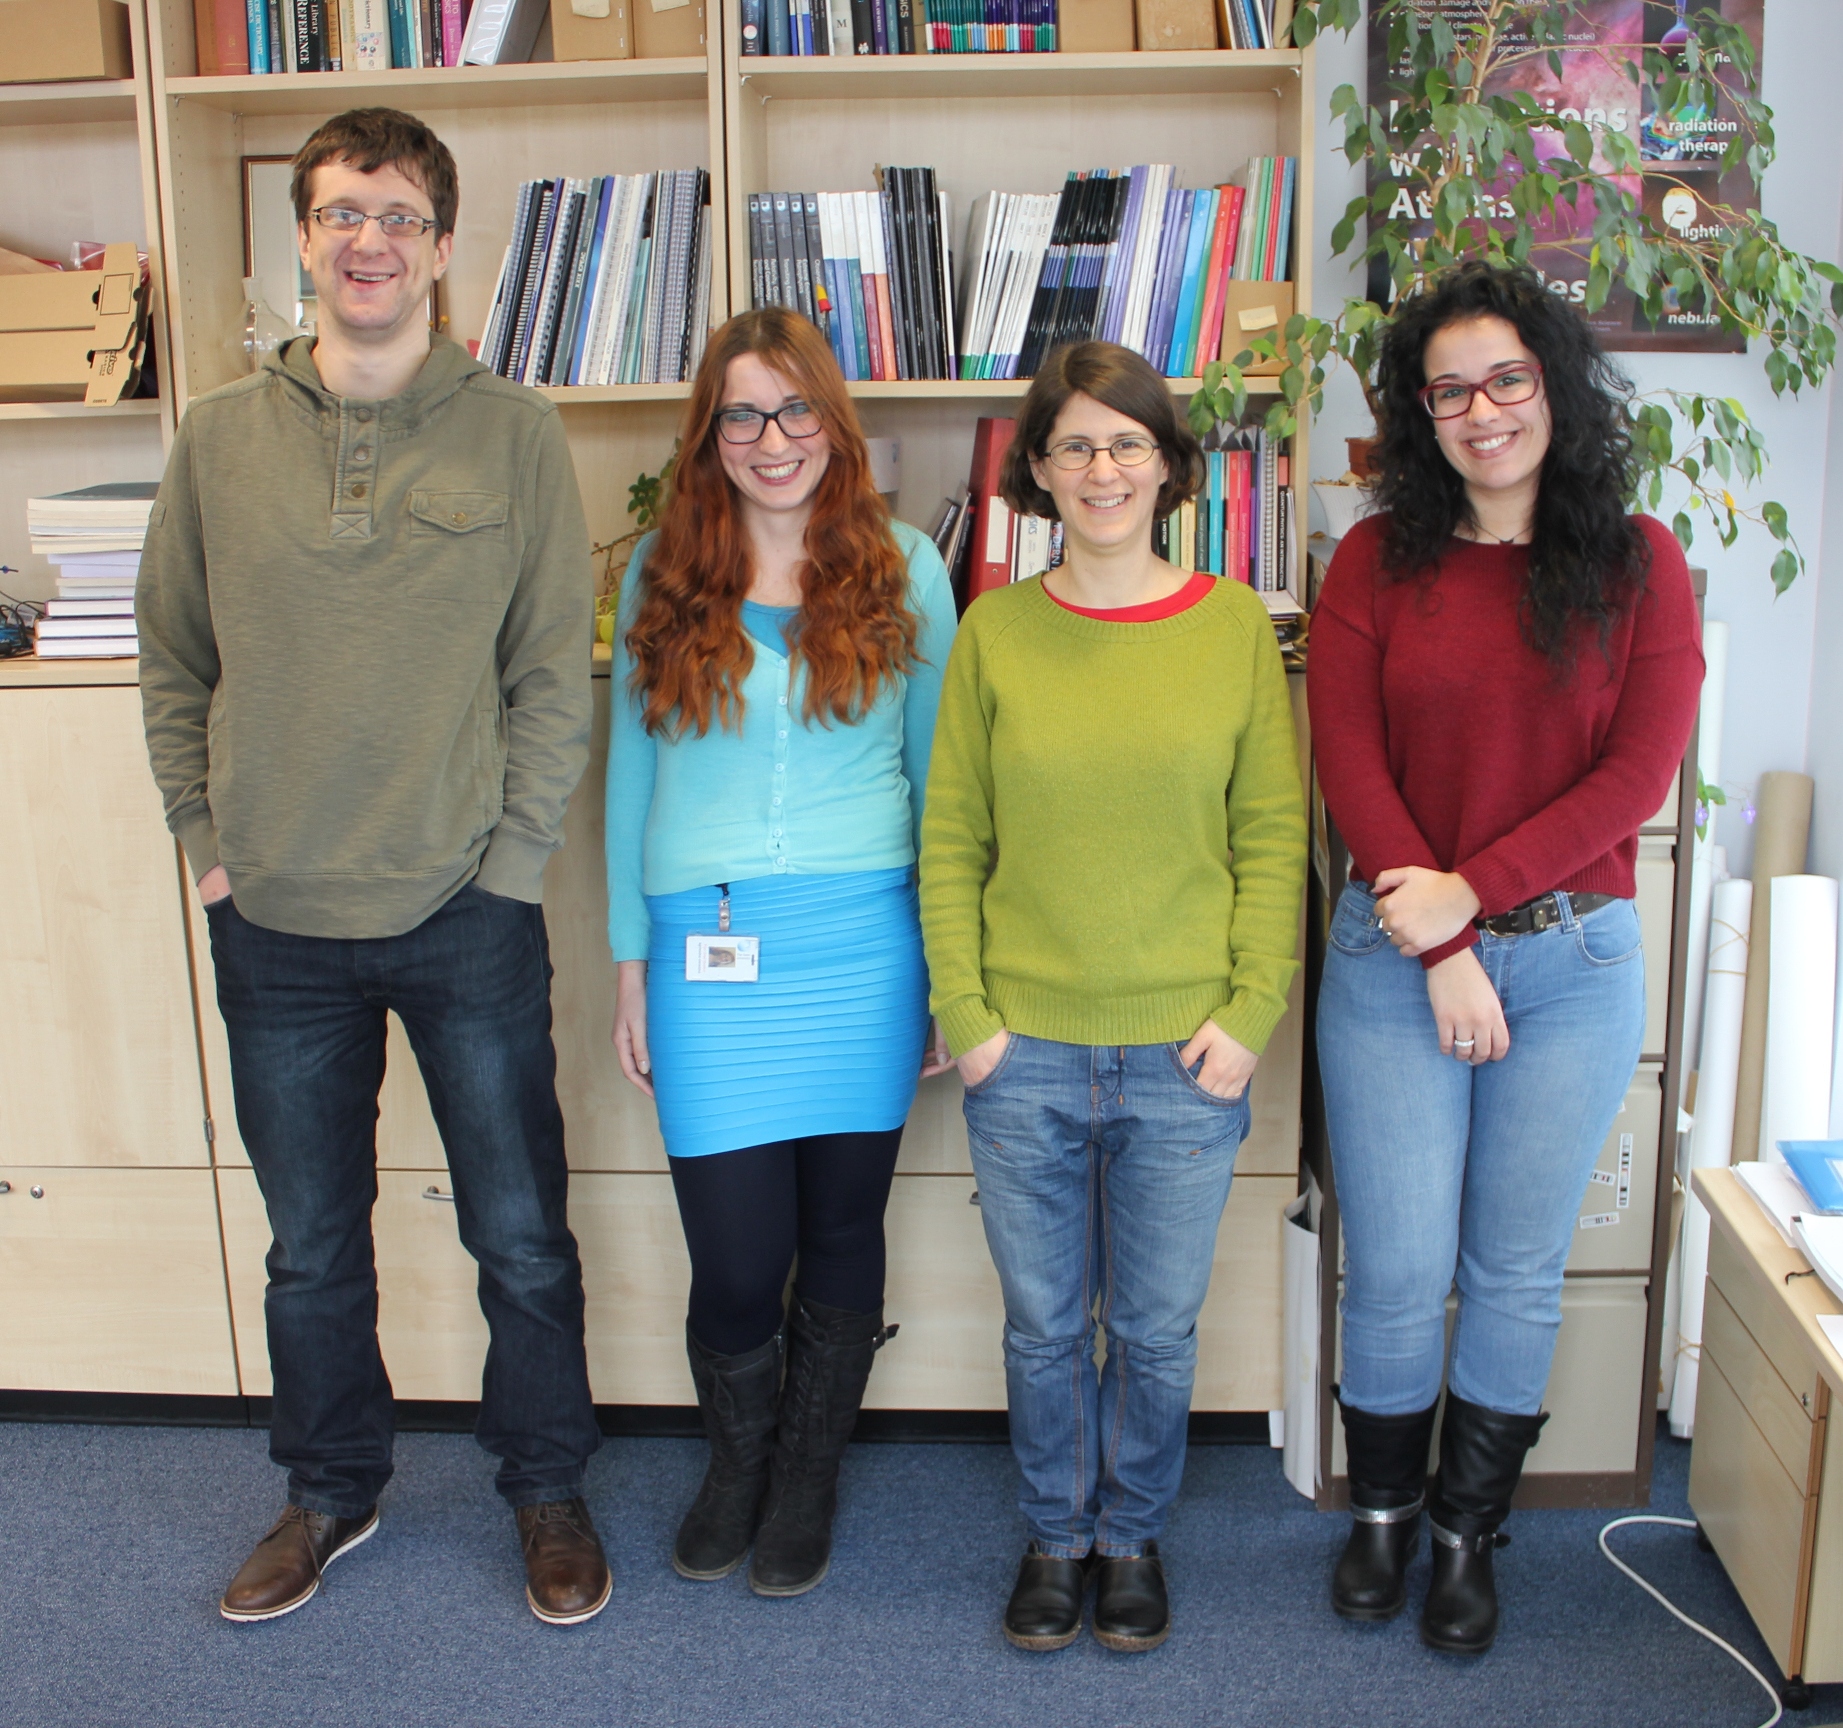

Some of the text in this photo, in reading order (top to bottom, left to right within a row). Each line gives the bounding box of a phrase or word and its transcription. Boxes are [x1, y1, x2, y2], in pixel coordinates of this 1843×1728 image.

[255, 15, 263, 55] DICTIONARY
[297, 0, 310, 64] REFERENCE
[310, 5, 319, 35] Library
[330, 14, 338, 52] PUBLIC
[837, 19, 847, 28] M
[1568, 32, 1595, 41] nuclei)
[1669, 118, 1737, 132] radiation
[1388, 143, 1475, 177] wh
[1679, 137, 1729, 154] therap
[1387, 186, 1518, 220] Atms
[578, 251, 586, 272] ICPEAC
[615, 273, 624, 302] CONFERENCE
[620, 242, 630, 272] PROGRAMME
[804, 282, 812, 315] Environment
